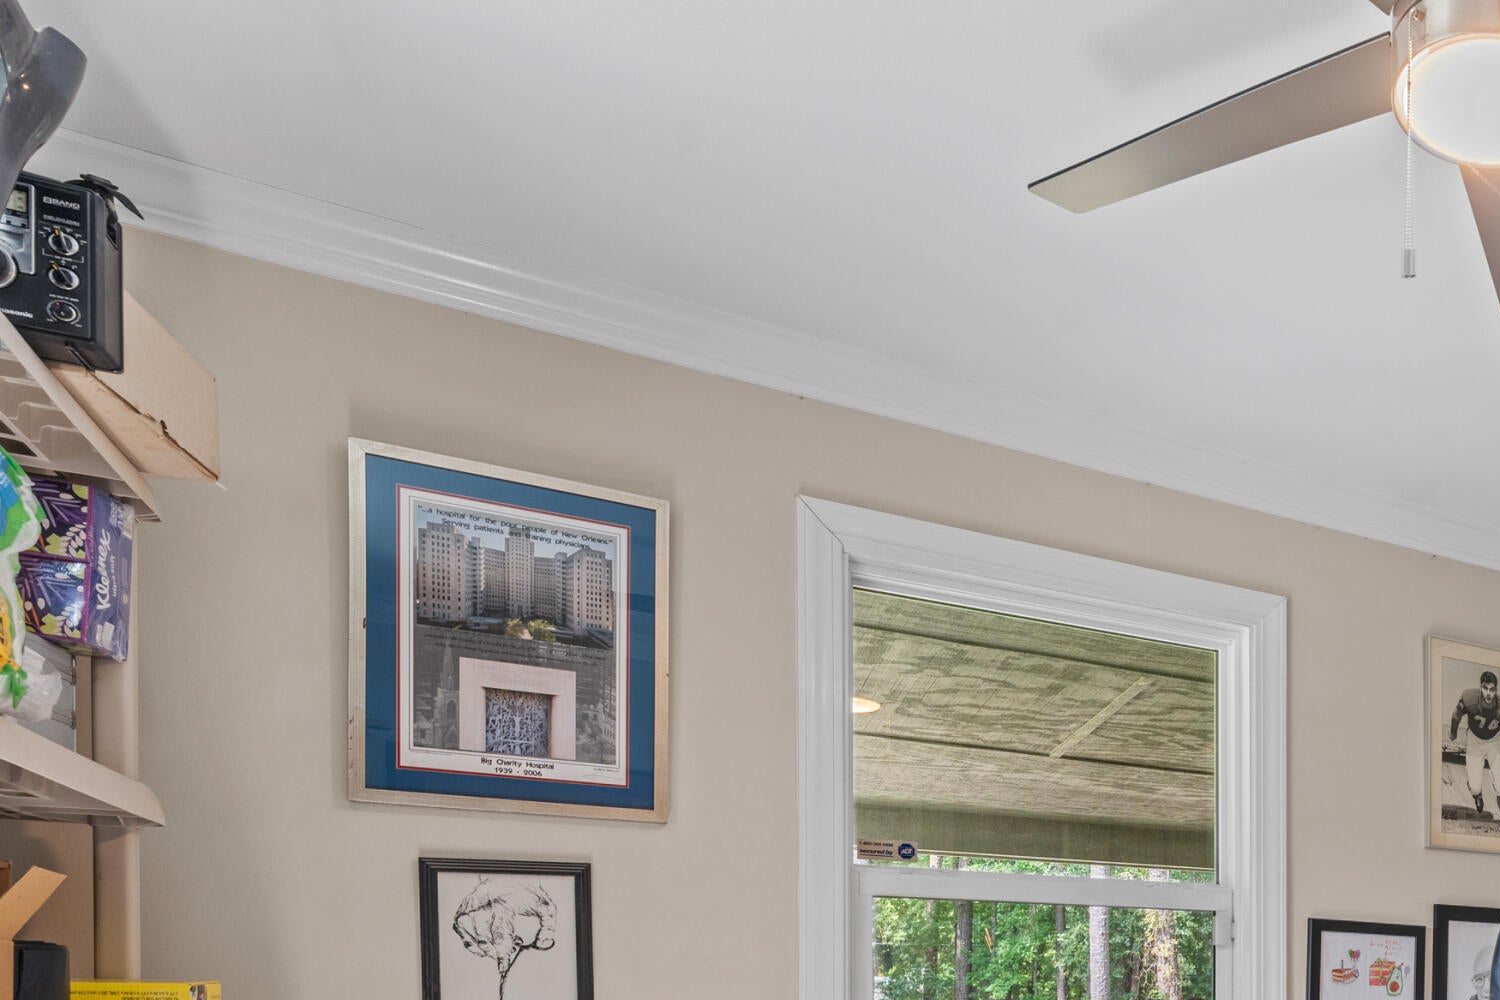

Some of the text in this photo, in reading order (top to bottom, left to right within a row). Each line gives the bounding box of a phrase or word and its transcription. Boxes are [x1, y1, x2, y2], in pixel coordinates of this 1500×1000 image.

[436, 507, 466, 520] hospital
[469, 514, 481, 522] for
[484, 516, 497, 525] the
[561, 531, 578, 539] New
[473, 524, 504, 535] patients
[95, 527, 112, 611] Kleenex
[480, 756, 555, 771] Big Charity Hospital
[494, 766, 514, 775] 1939
[523, 769, 543, 777] 2006
